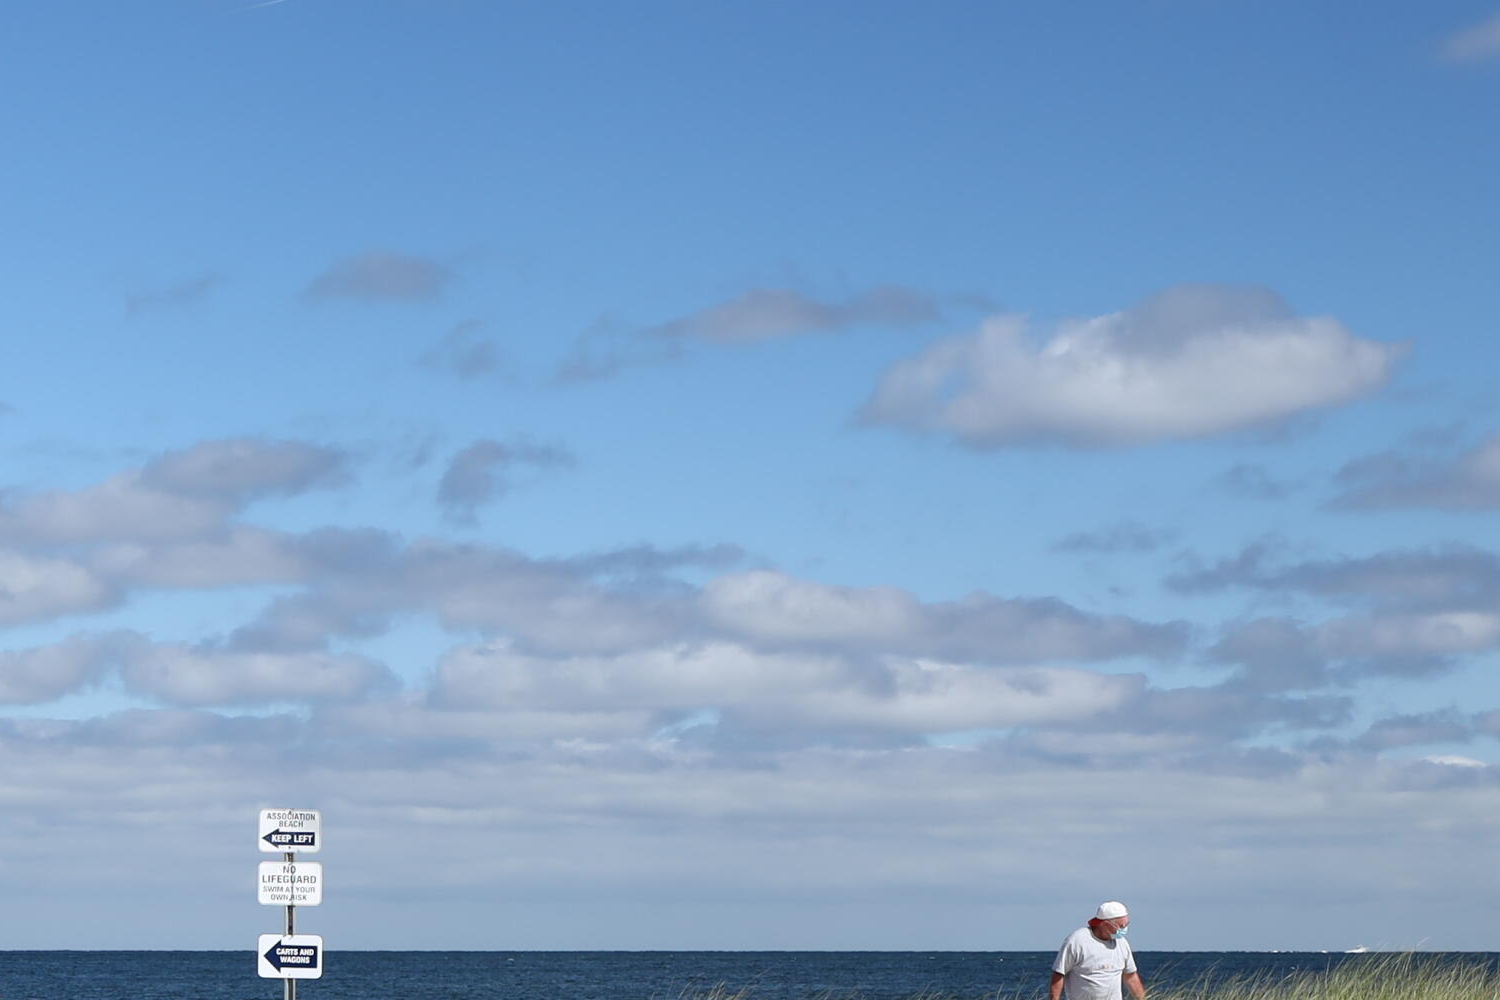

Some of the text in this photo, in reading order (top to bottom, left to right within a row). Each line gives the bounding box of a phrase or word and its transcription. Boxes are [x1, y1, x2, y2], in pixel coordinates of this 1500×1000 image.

[278, 820, 304, 828] BEACH
[271, 834, 313, 843] KEEP LEFT
[282, 865, 297, 874] NO
[261, 874, 317, 884] LIFEGUARD
[276, 947, 315, 956] CARTS AND
[279, 955, 311, 964] WAGONS
